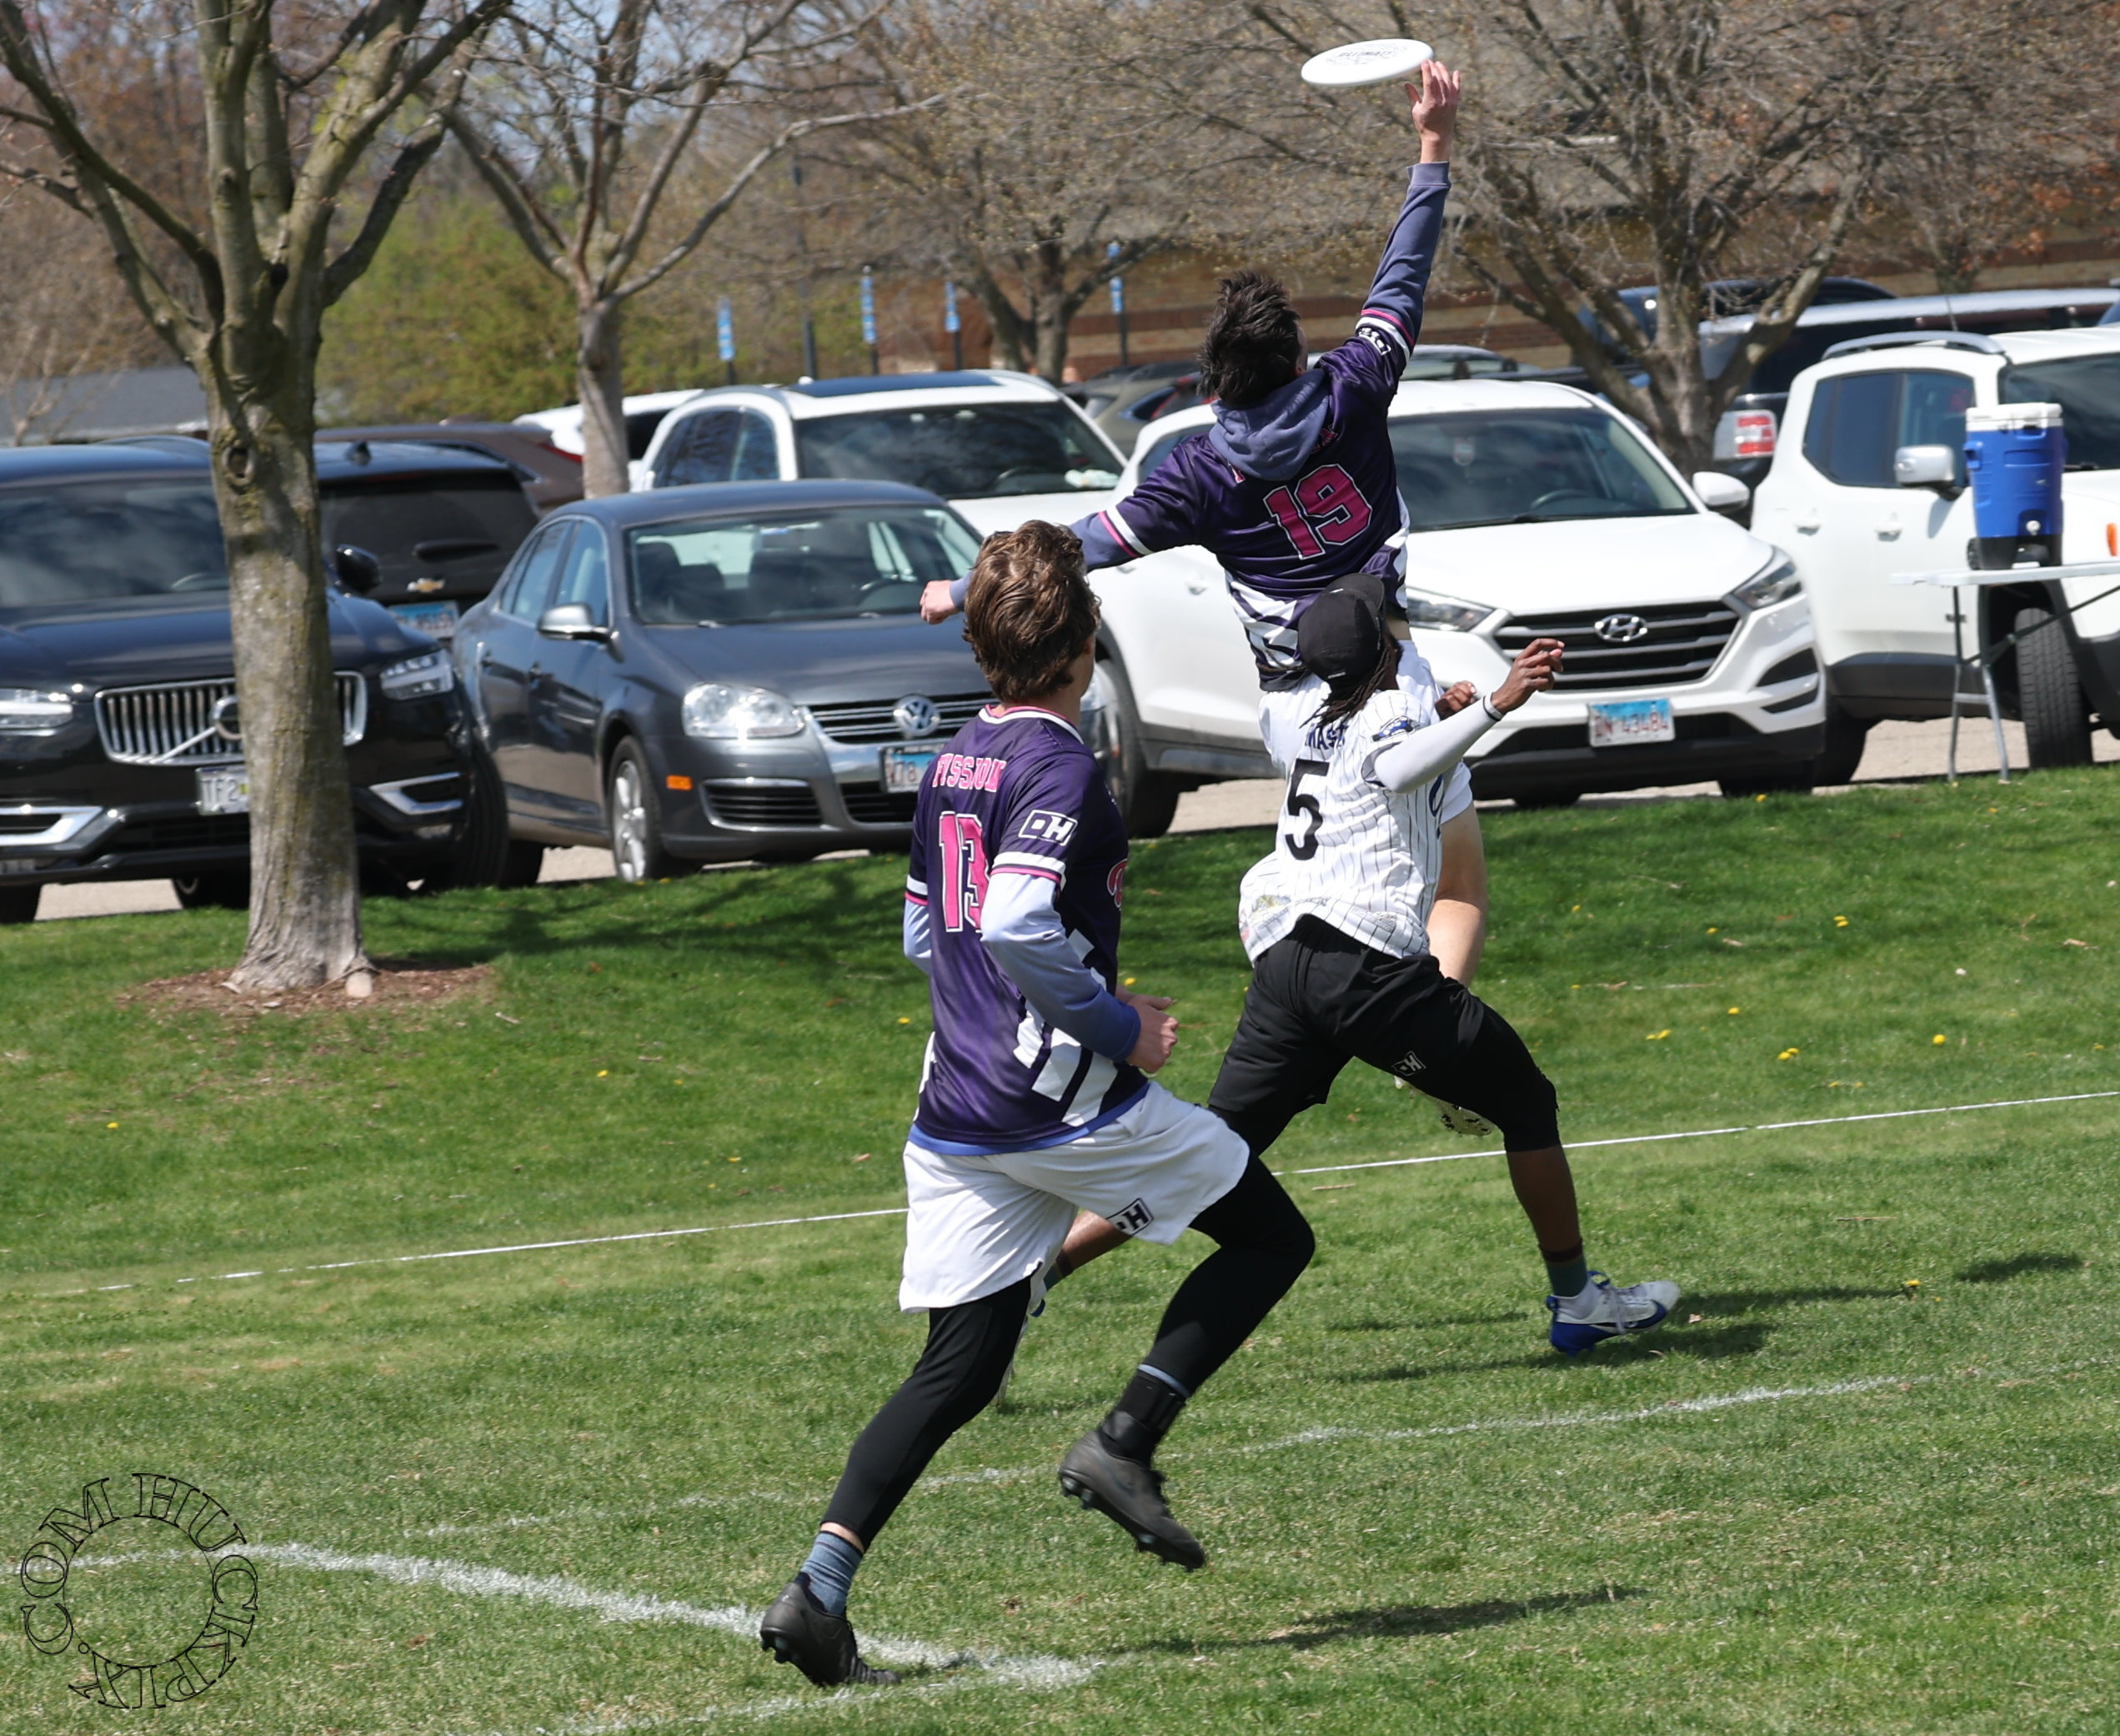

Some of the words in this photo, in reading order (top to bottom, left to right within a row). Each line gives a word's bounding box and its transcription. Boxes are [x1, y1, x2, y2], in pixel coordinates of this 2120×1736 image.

[1263, 463, 1372, 560] 19
[1284, 757, 1331, 861] 5
[939, 810, 990, 933] 13
